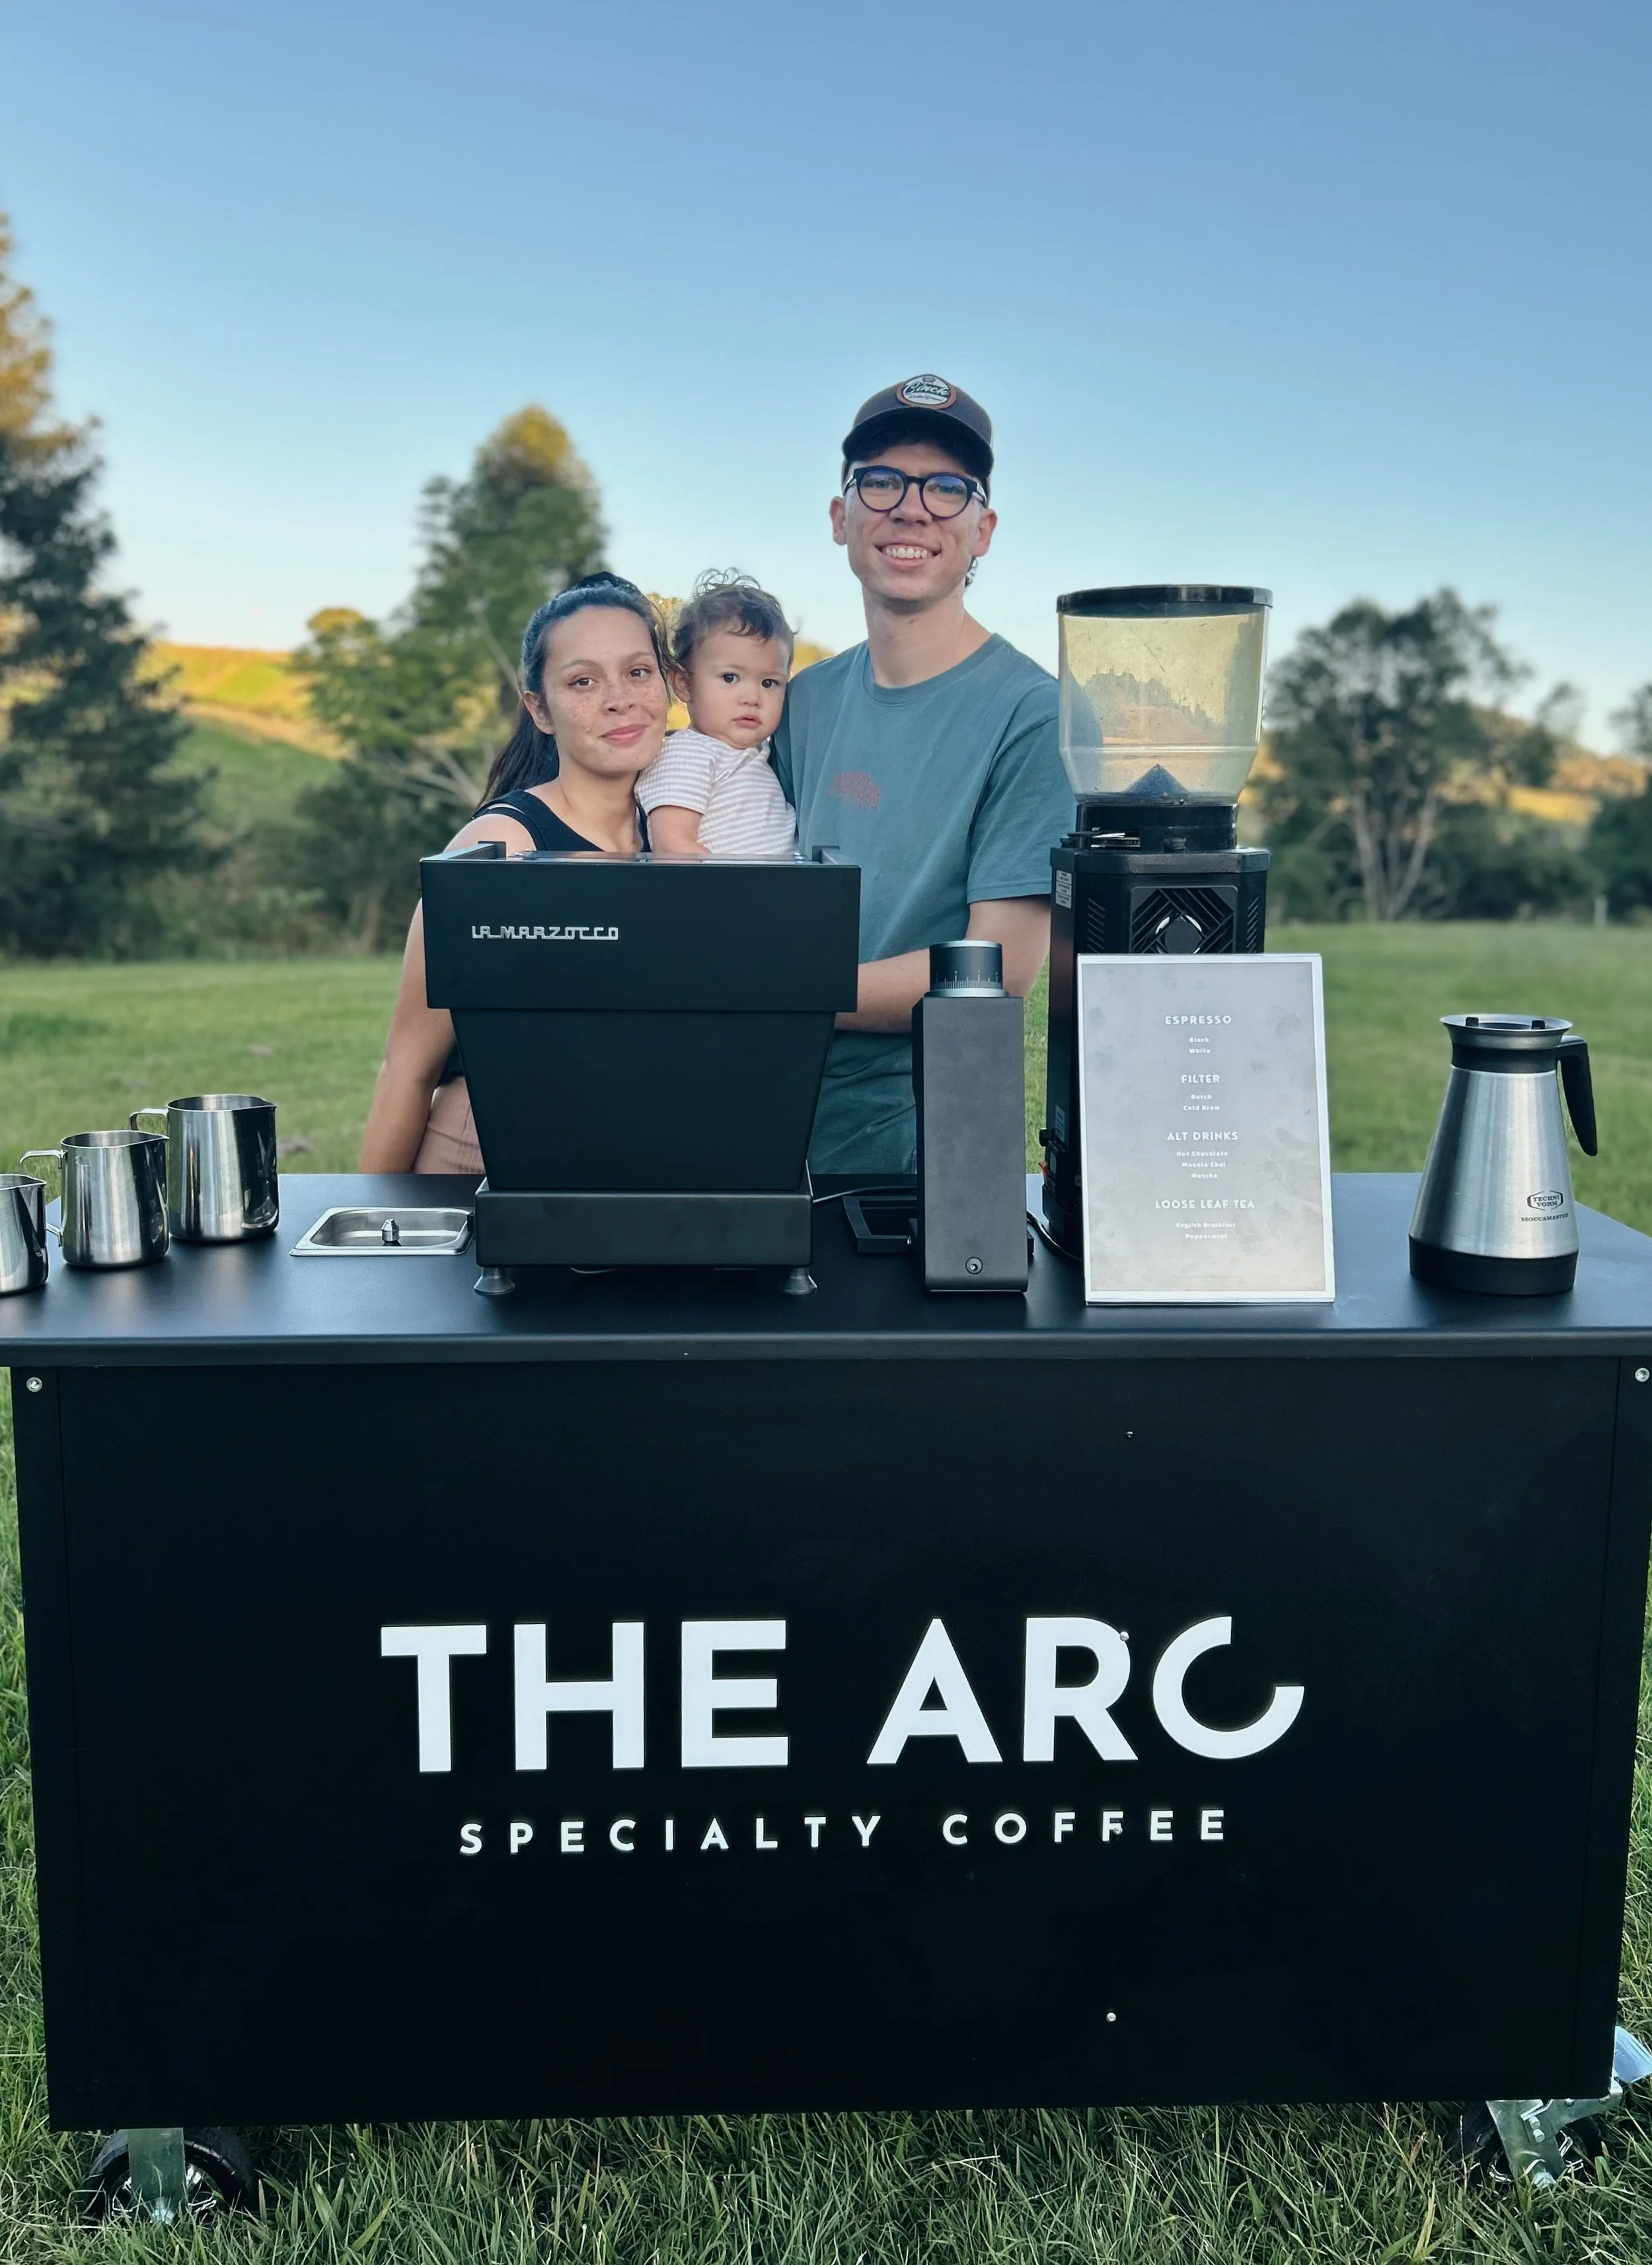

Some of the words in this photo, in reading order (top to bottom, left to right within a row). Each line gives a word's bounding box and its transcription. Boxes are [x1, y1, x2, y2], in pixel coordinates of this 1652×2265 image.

[1166, 1016, 1231, 1024] ESPRESSO
[1193, 1132, 1238, 1140] DRINKS
[1201, 1200, 1228, 1208] LEAF
[381, 1620, 788, 1772] THE
[867, 1616, 1304, 1764] ARC
[460, 1816, 881, 1854] SPECIALTY
[943, 1810, 1224, 1845] COFFEE
